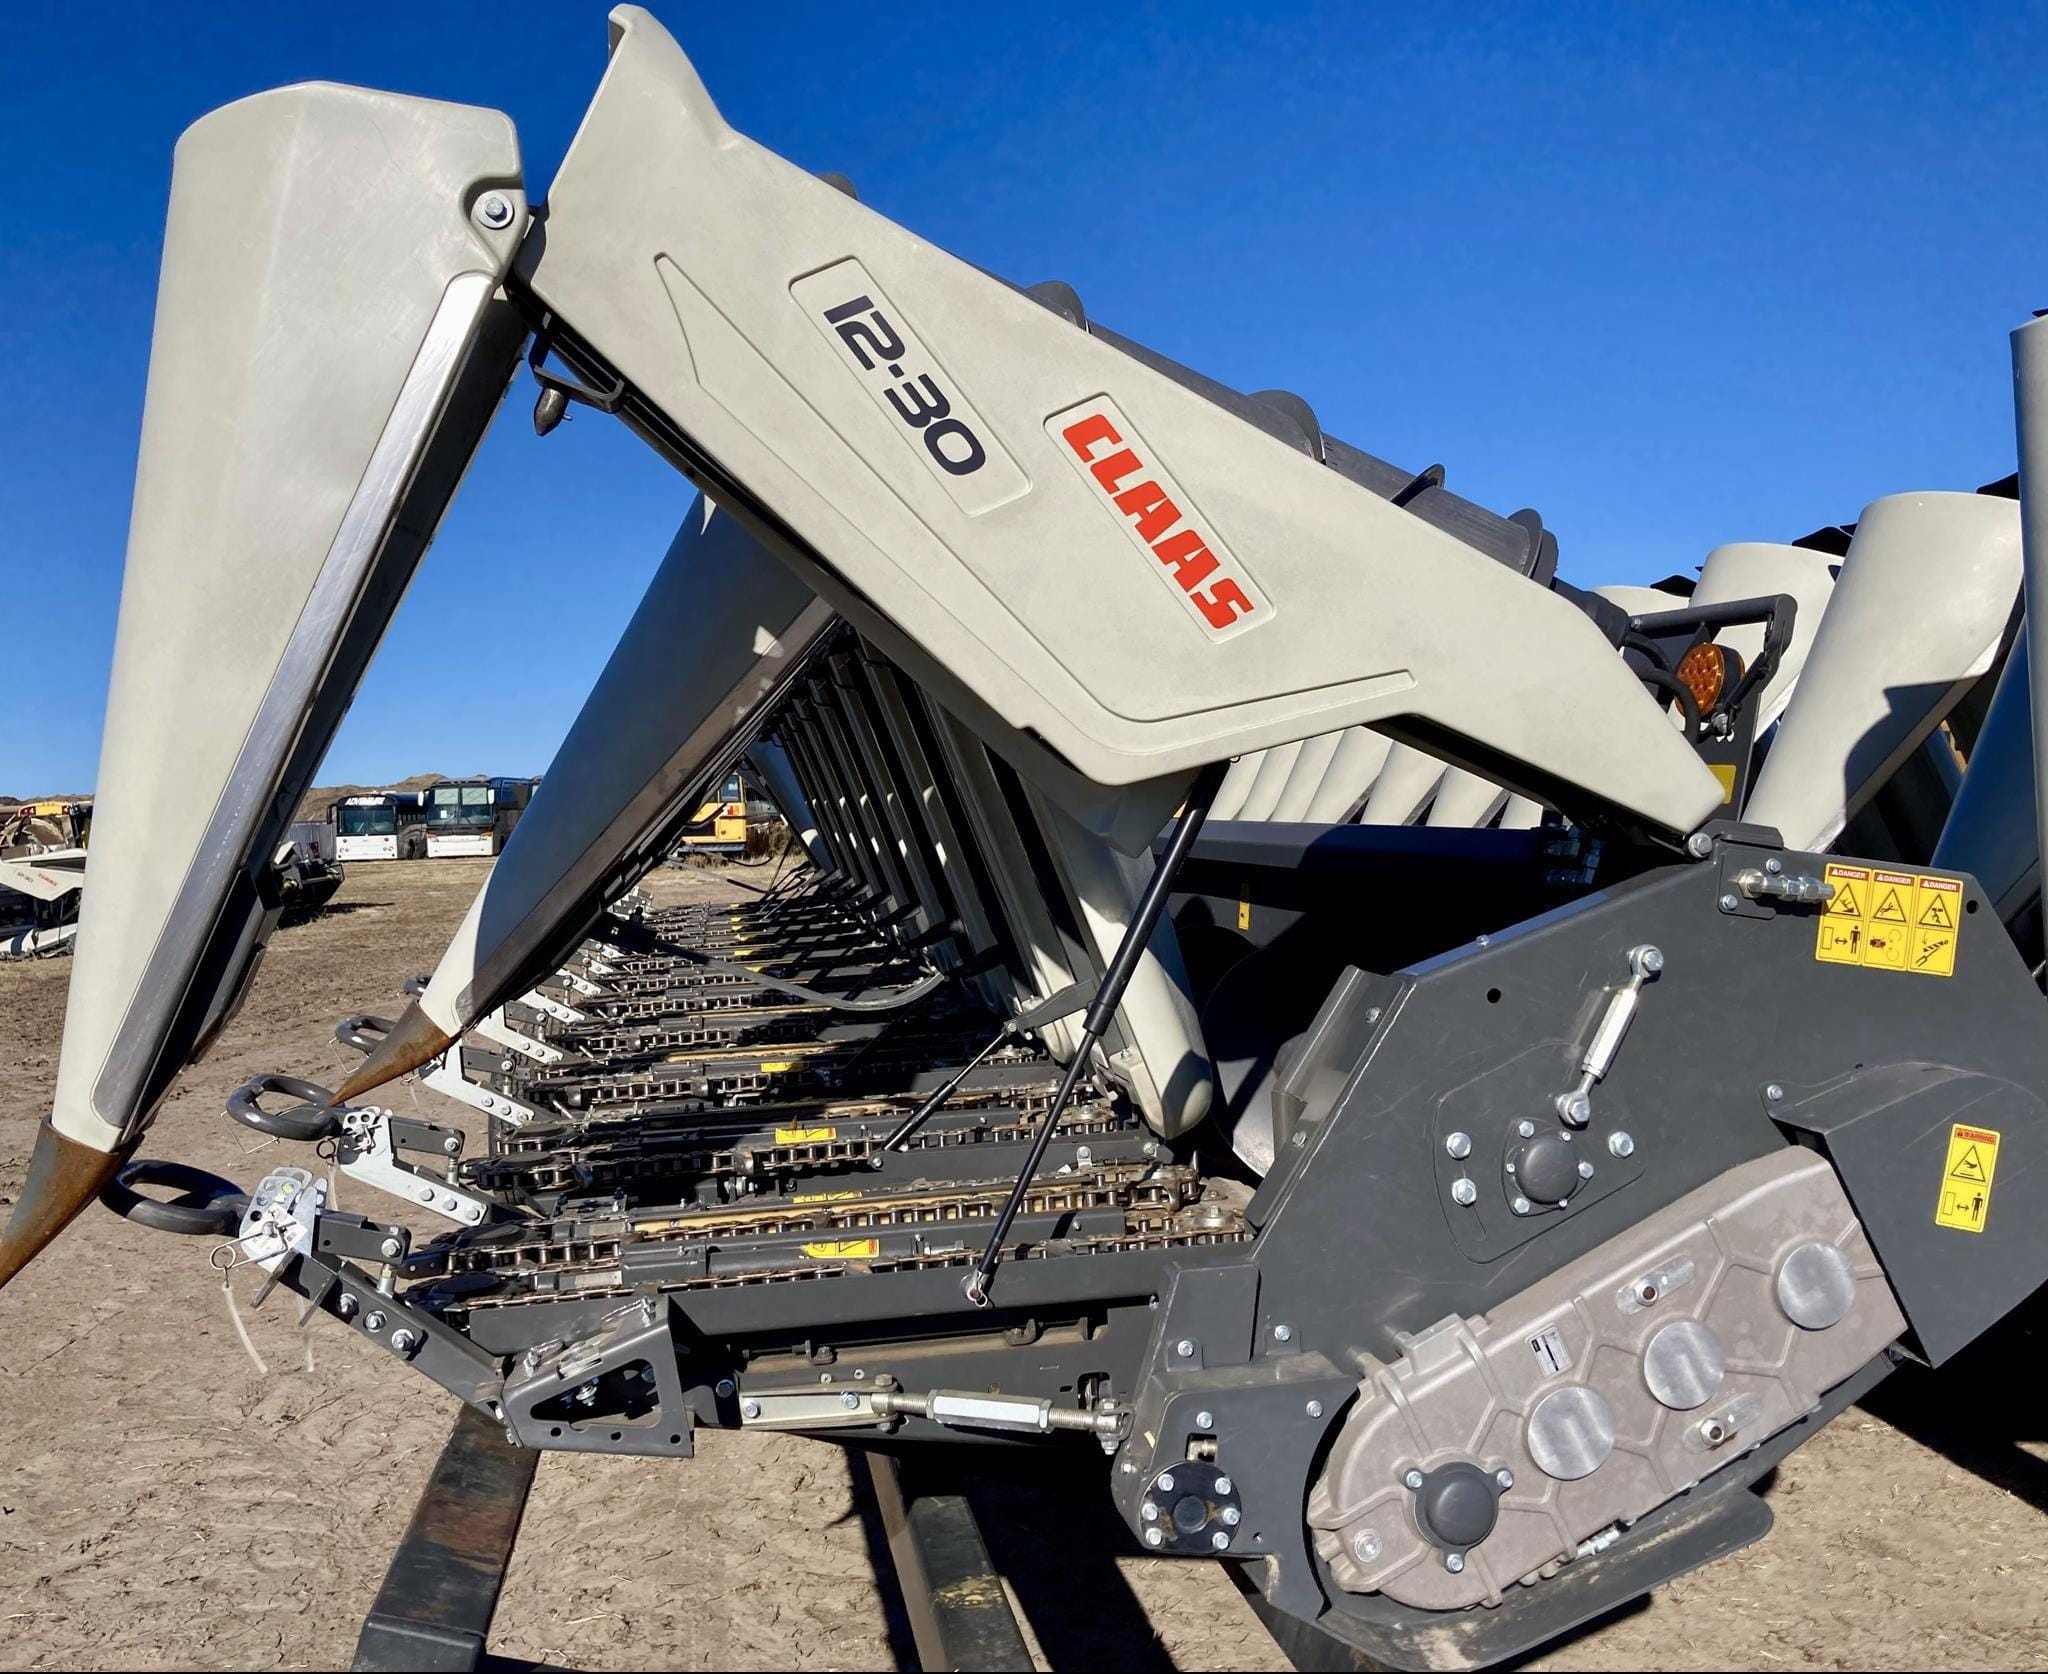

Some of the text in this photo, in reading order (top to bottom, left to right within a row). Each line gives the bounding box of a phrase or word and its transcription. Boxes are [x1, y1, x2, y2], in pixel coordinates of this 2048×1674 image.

[1062, 414, 1254, 629] CLAAS
[1838, 870, 1866, 879] DANGER
[1884, 875, 1911, 885] DANGER
[1929, 881, 1957, 891] DANGER
